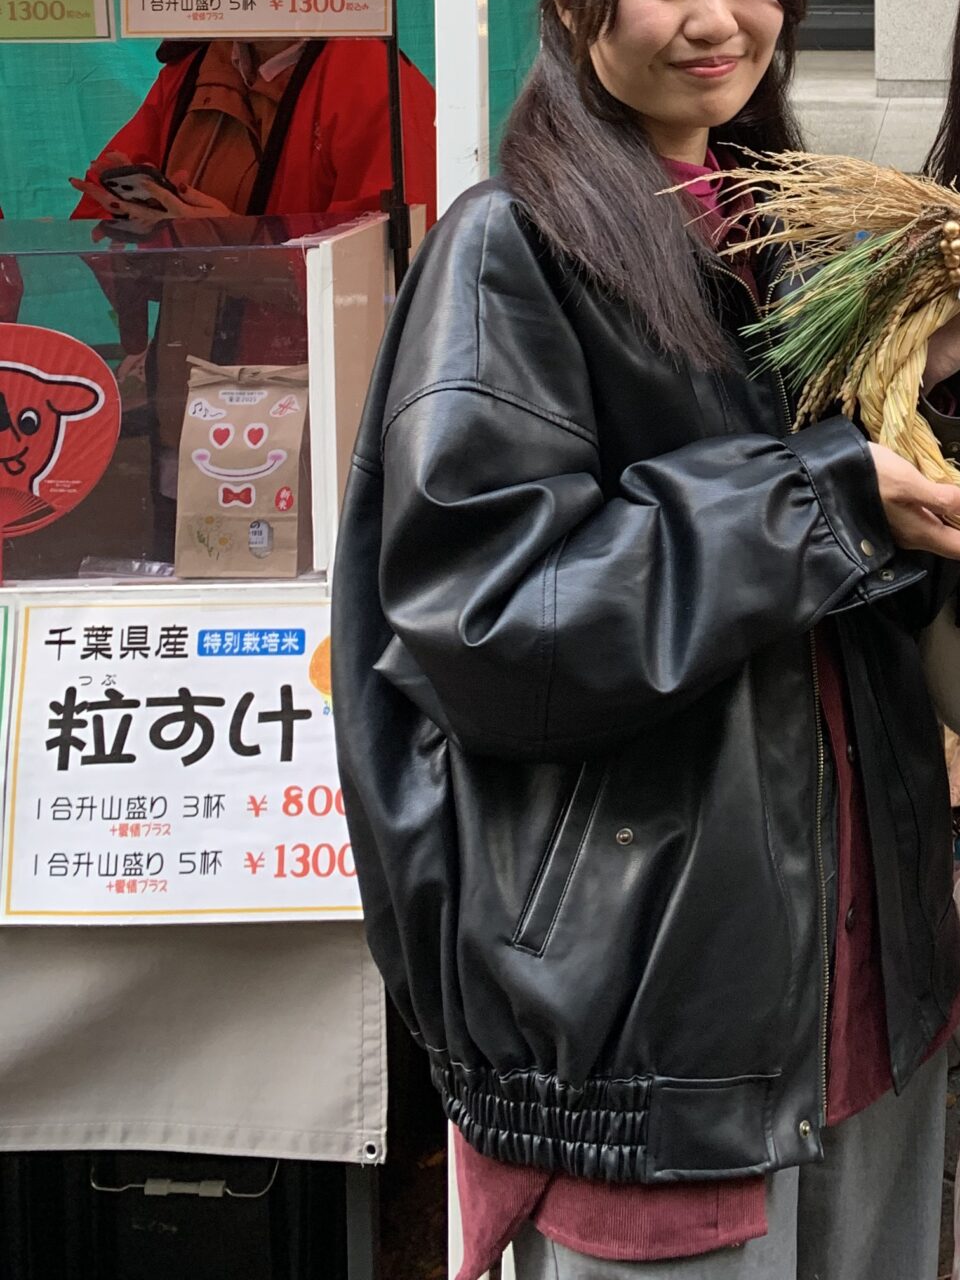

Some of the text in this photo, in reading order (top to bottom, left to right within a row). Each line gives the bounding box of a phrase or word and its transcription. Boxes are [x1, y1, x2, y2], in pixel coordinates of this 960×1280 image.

[0, 0, 66, 21] 1300
[44, 624, 301, 661] 千葉県産 特別栽培米
[78, 673, 117, 687] つぶ
[45, 684, 312, 771] 粒すけ
[182, 793, 226, 819] 3杯
[179, 850, 223, 876] 5杯
